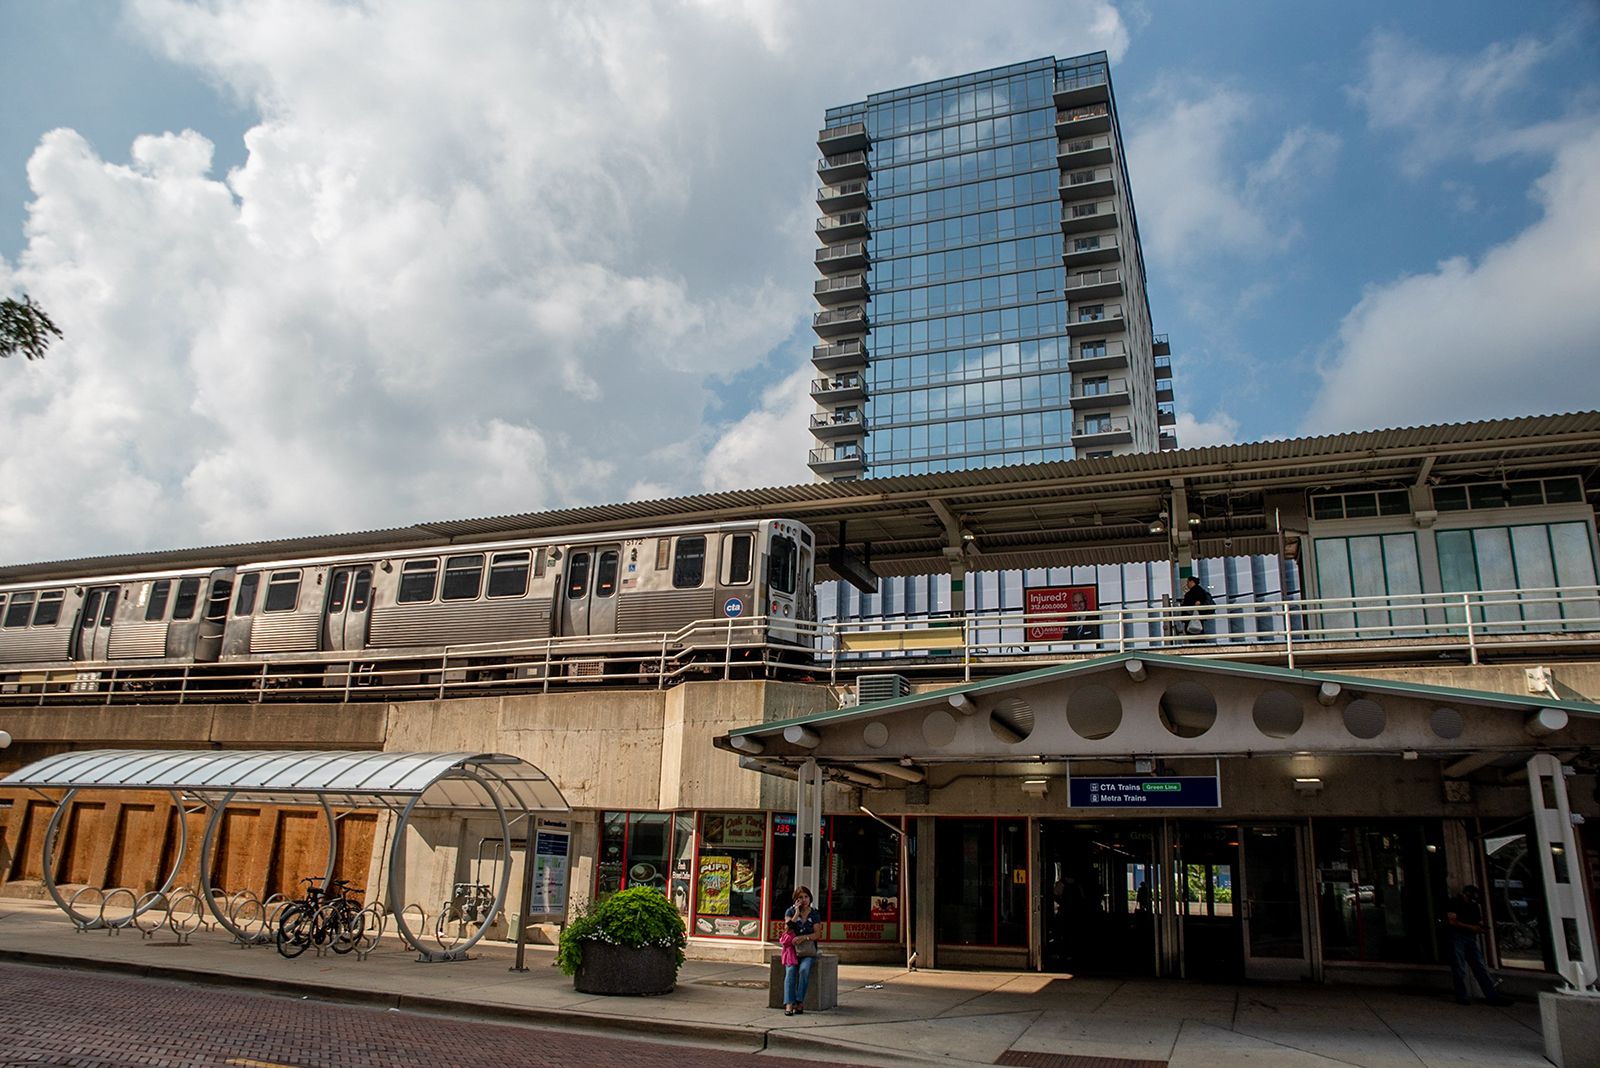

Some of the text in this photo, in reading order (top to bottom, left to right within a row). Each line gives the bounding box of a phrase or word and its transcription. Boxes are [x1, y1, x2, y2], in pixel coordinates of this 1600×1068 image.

[625, 539, 643, 547] 5172
[1030, 592, 1068, 604] Injured?
[726, 602, 741, 612] cta
[1030, 603, 1068, 611] 312.600.0000
[1100, 783, 1116, 791] CTA
[1117, 783, 1141, 791] Trains
[1100, 794, 1147, 802] Metra Trains
[725, 815, 743, 829] Oak
[745, 815, 764, 831] Park
[776, 824, 790, 833] 135
[842, 923, 885, 932] NEWSPAPERS
[845, 931, 882, 940] MAGAZINES
